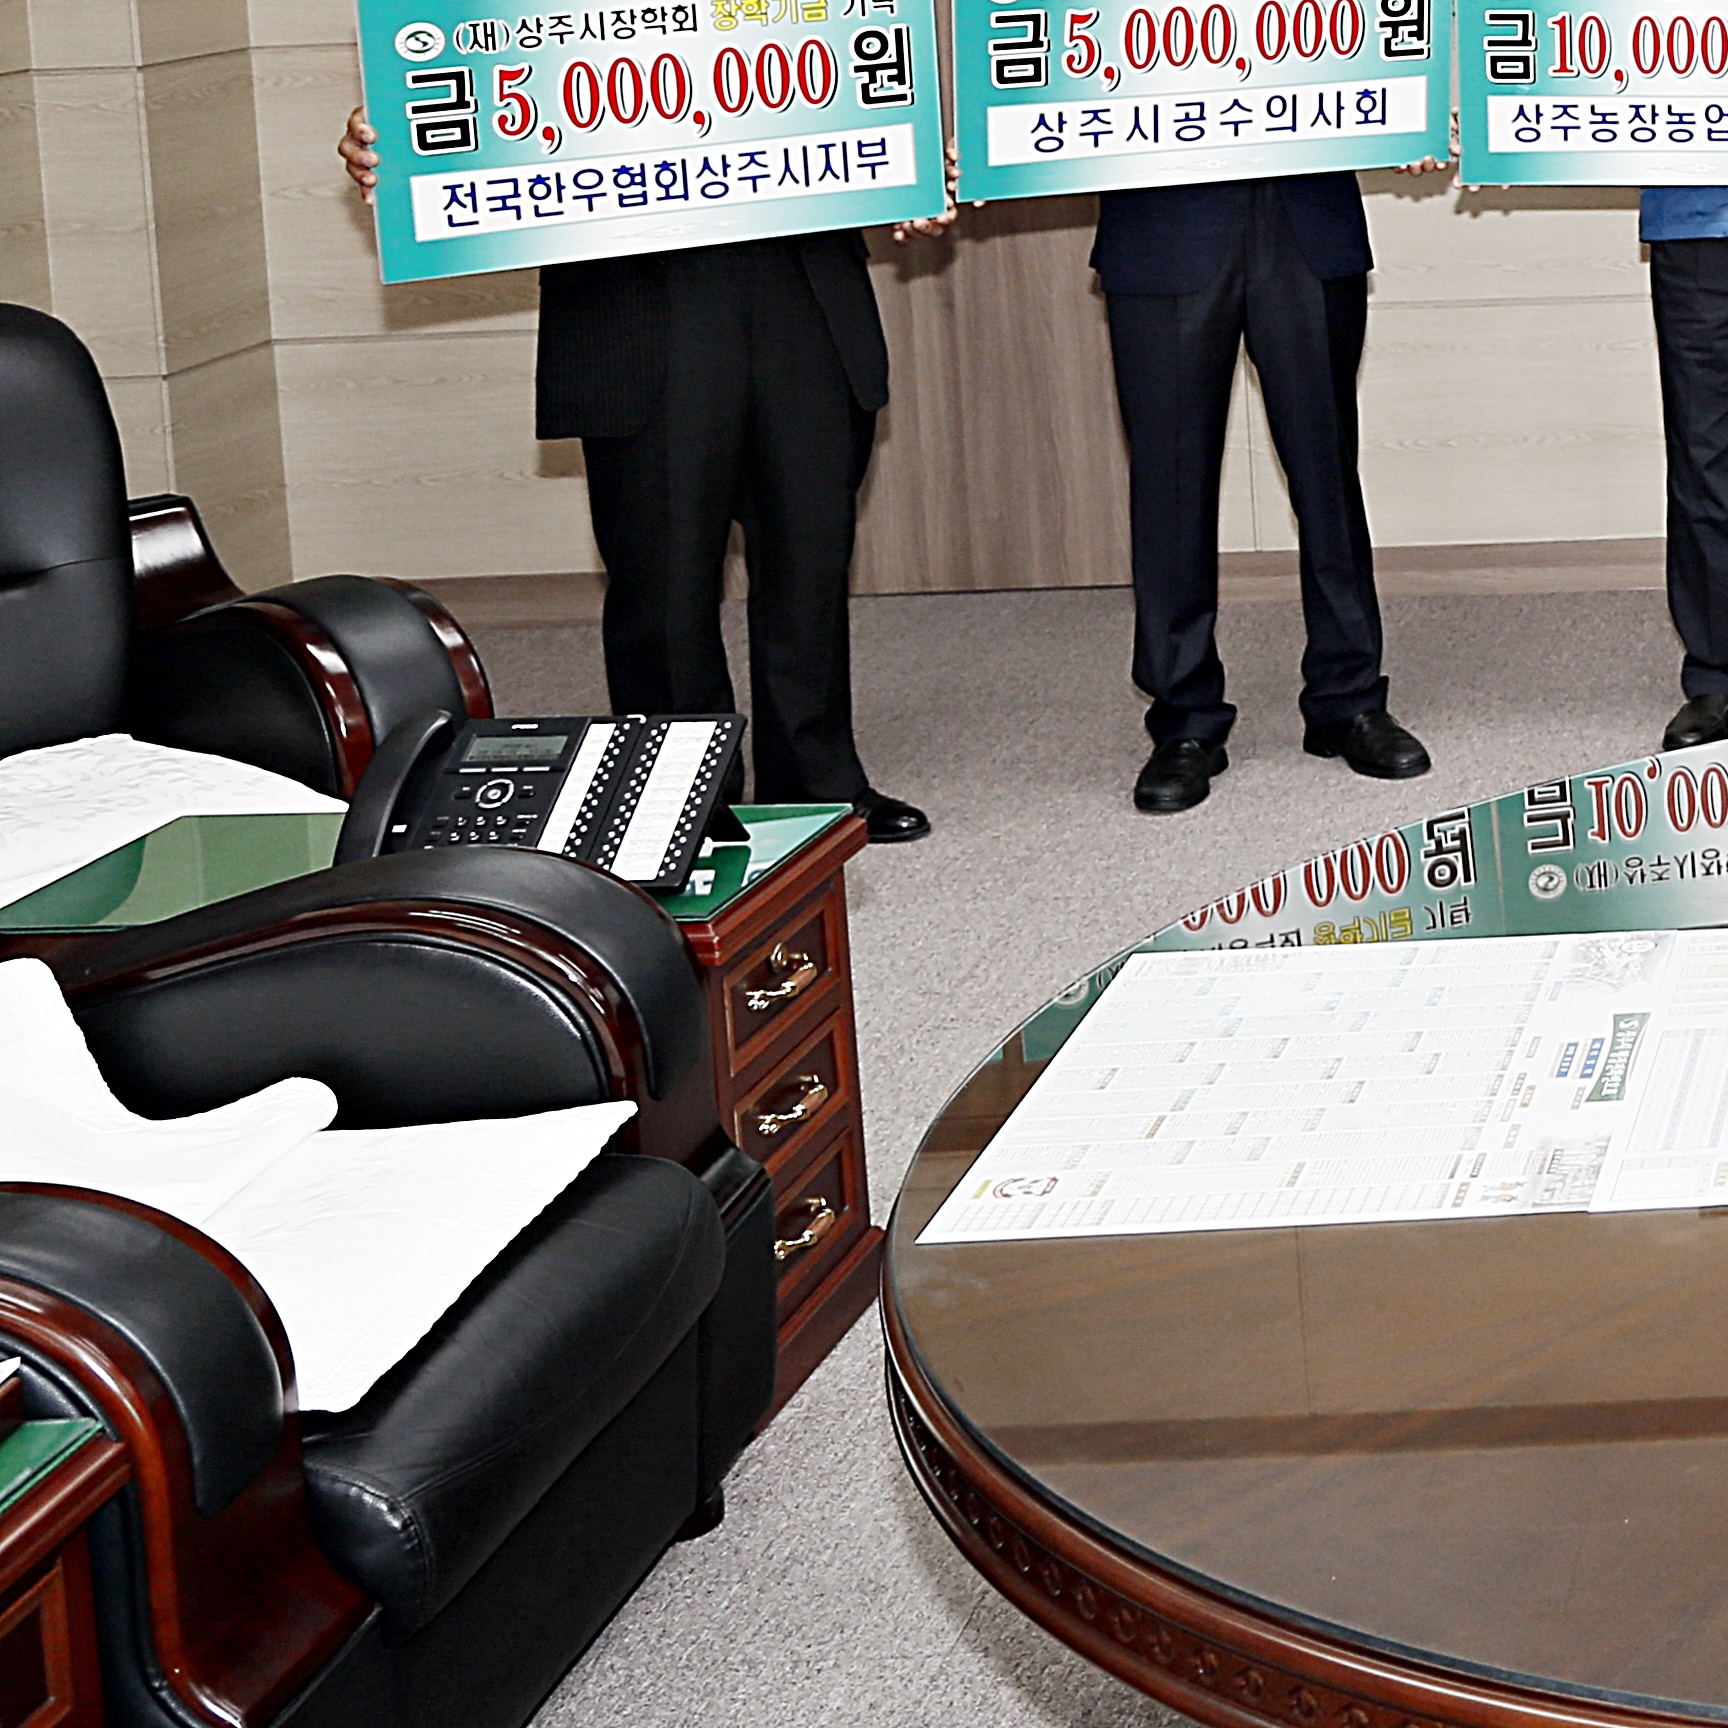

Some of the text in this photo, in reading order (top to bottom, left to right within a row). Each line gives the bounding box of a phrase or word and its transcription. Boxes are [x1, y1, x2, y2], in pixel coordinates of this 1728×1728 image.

[454, 3, 698, 54] (재)상주시장학회
[989, 11, 1048, 86] 금
[1484, 11, 1536, 83] 금
[407, 26, 914, 153] 금 5,000,000 원
[1030, 87, 1388, 154] 상주시공수의사회
[442, 137, 891, 229] 전국한우협회상주시지부
